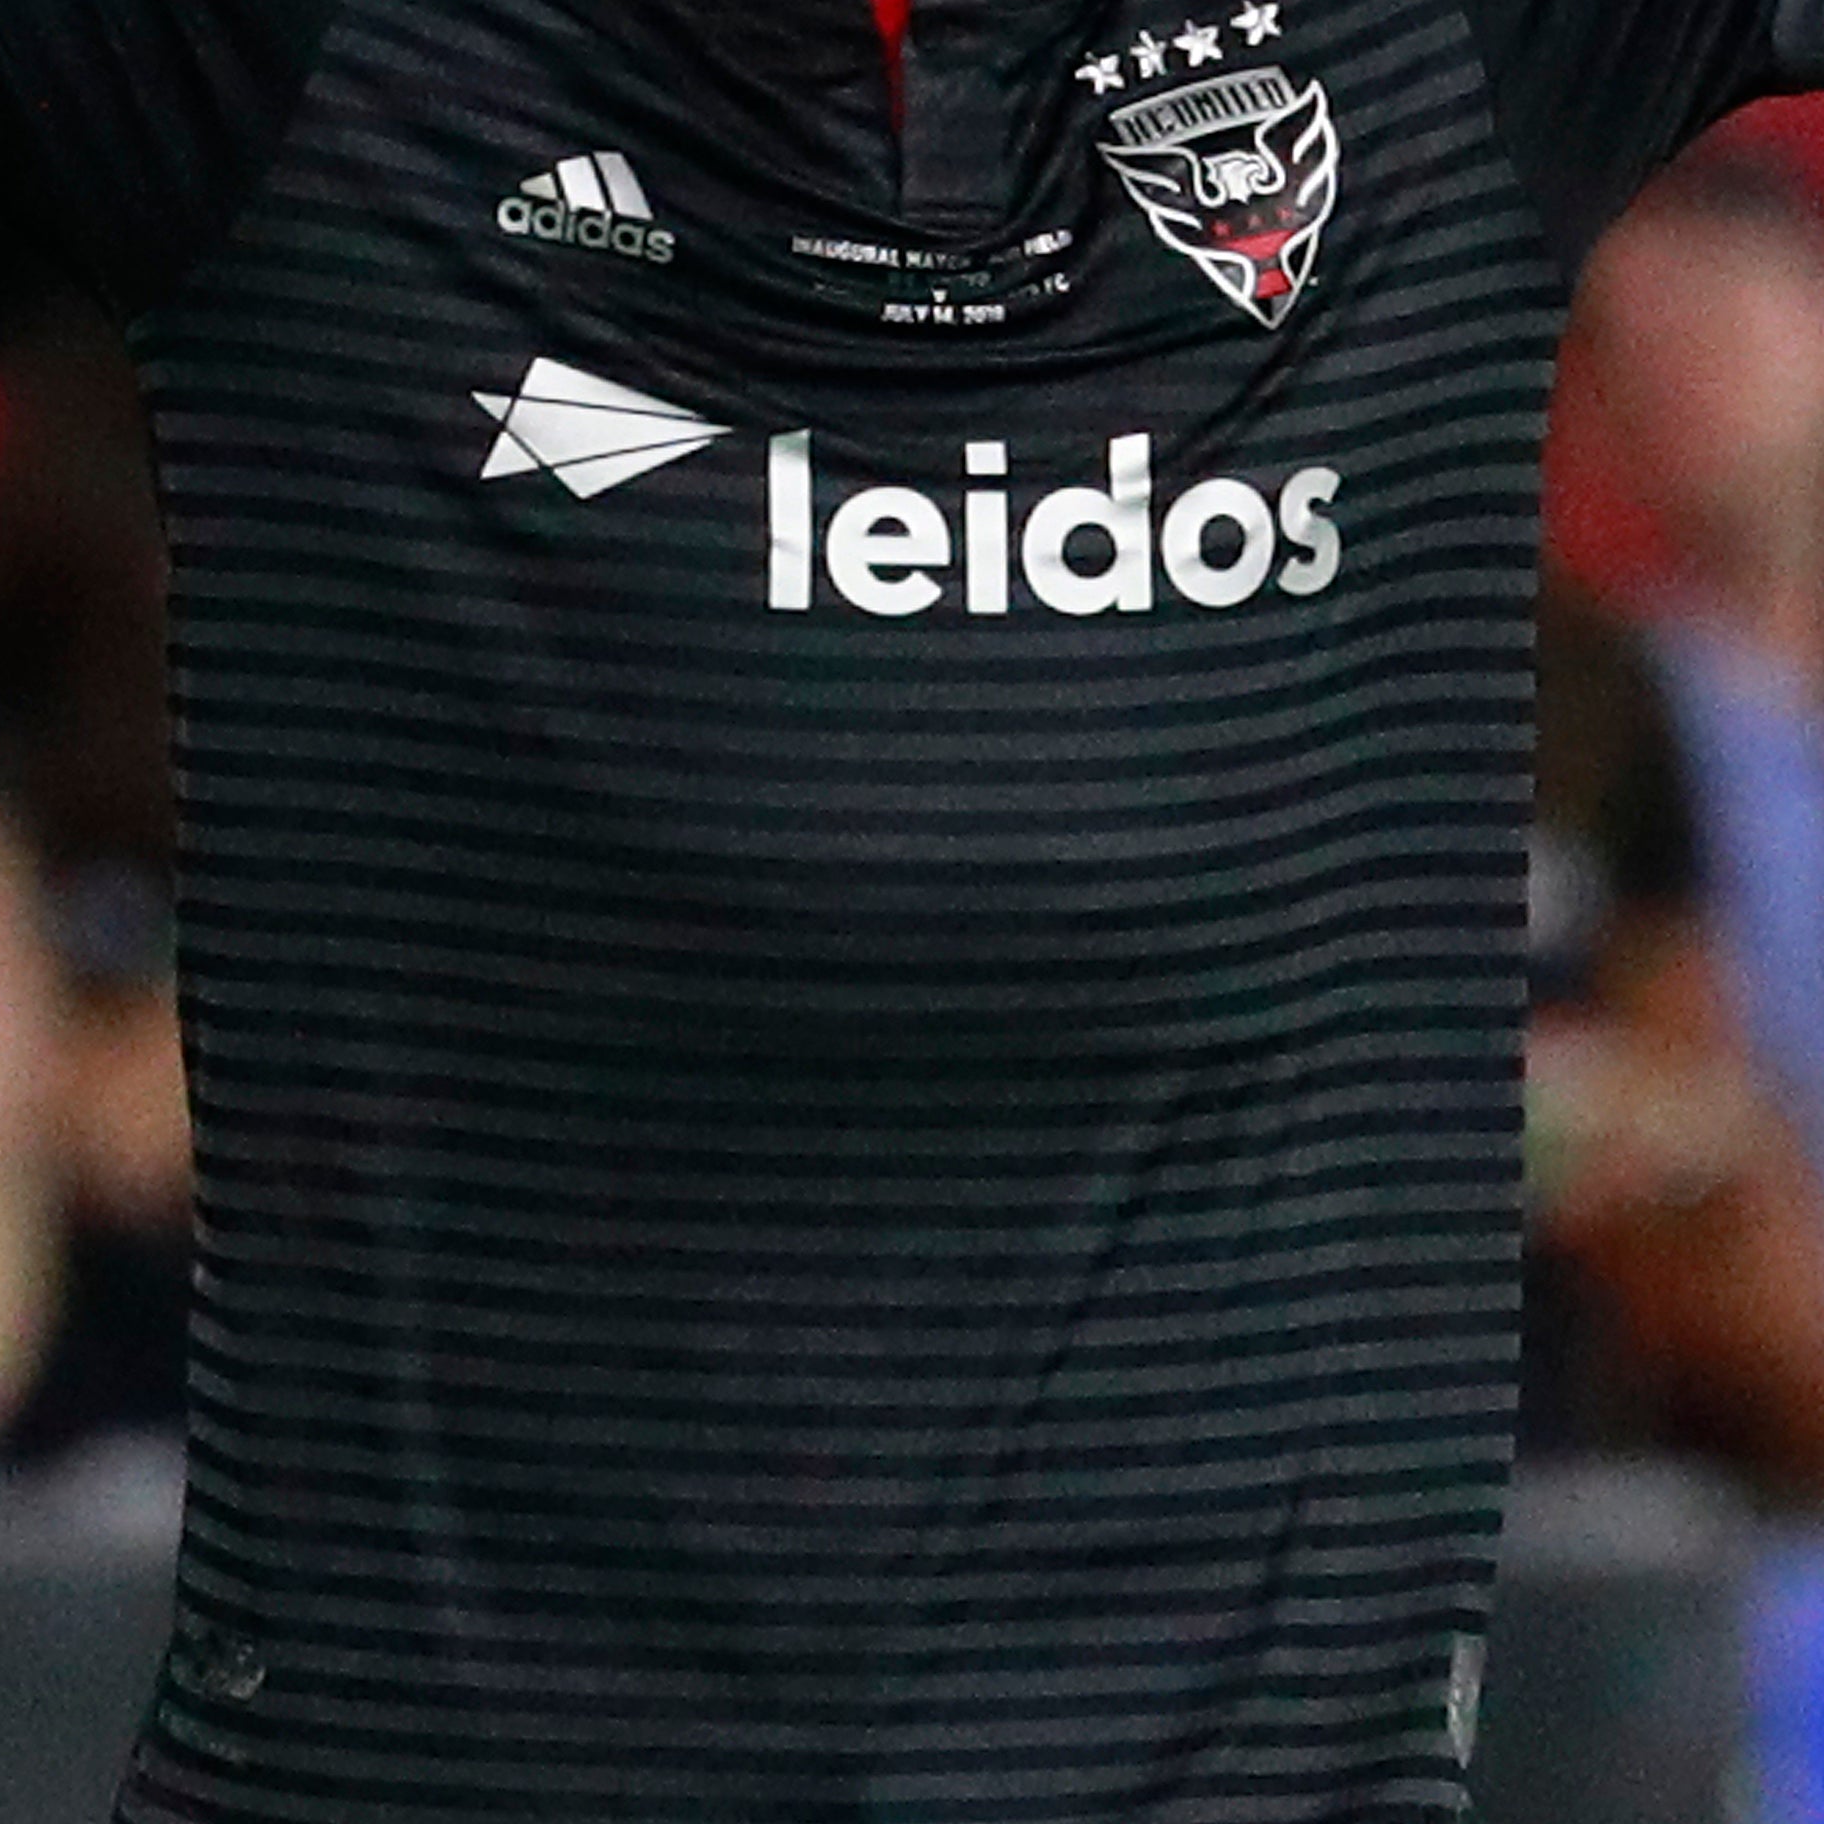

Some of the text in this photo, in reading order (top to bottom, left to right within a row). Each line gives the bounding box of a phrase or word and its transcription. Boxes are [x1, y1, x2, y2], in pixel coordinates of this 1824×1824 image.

[1172, 78, 1288, 128] UNITED
[497, 196, 676, 265] adidas
[767, 428, 1342, 616] leidos
